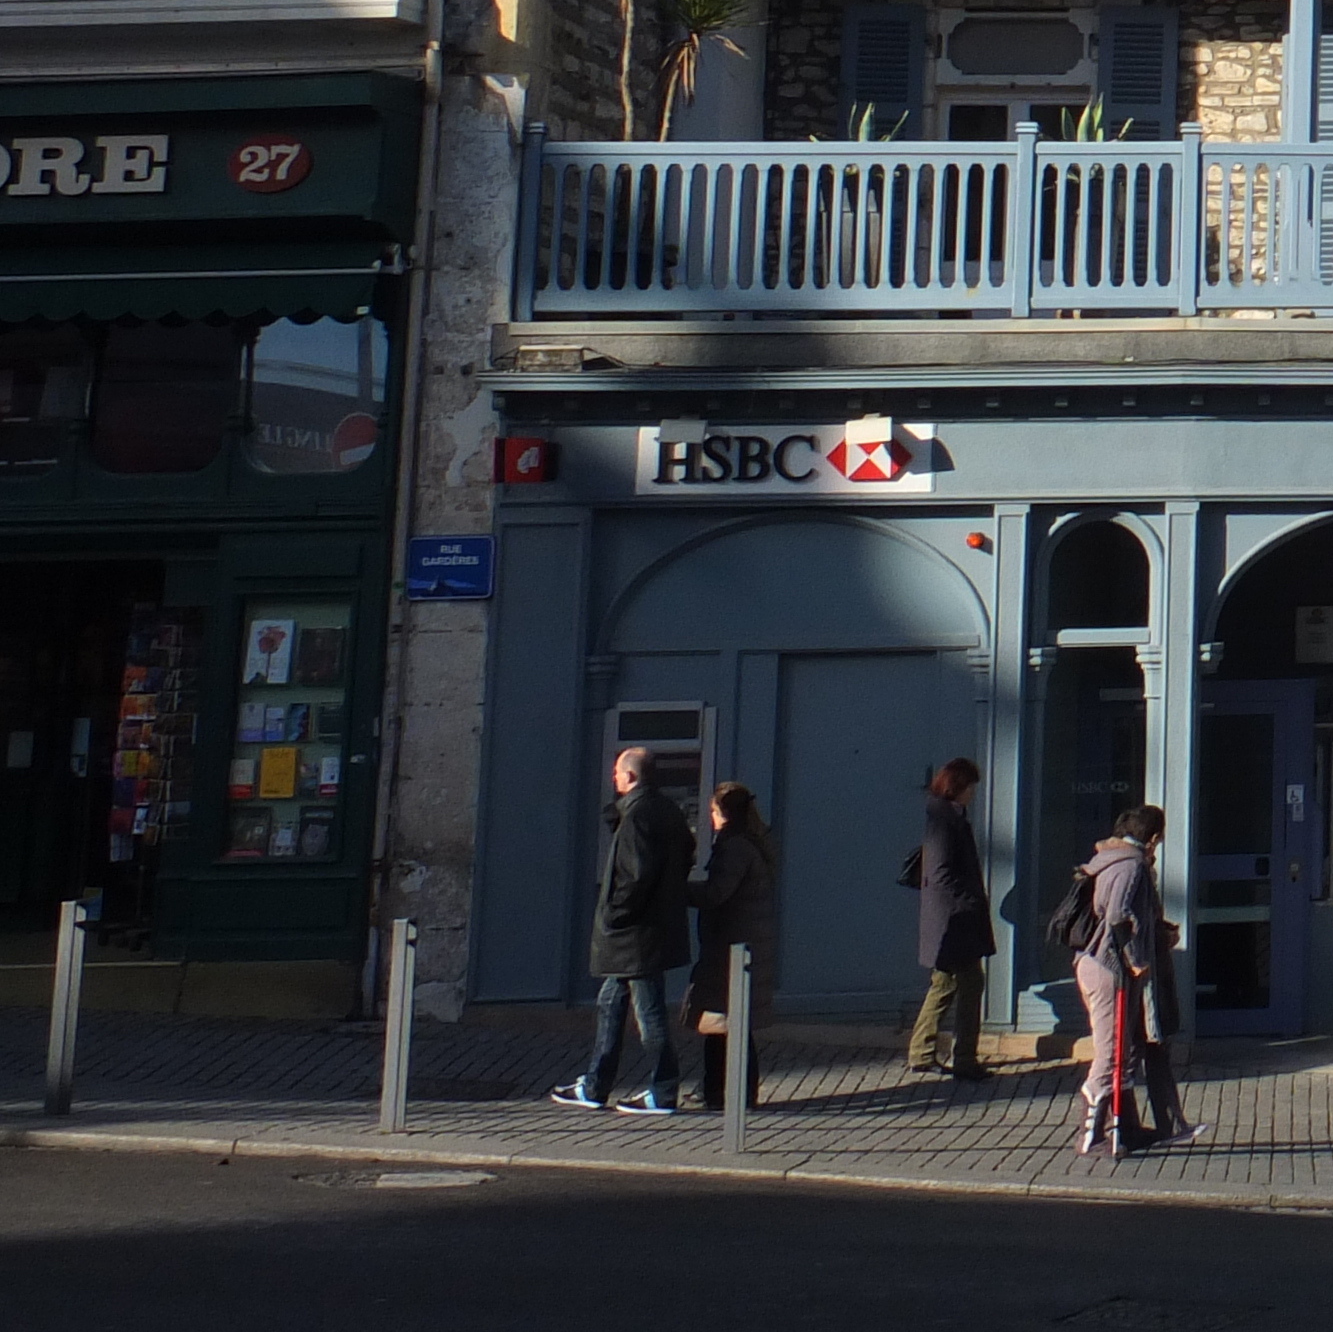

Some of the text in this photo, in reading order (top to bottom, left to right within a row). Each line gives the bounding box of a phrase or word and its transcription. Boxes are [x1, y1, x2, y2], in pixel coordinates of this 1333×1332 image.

[240, 144, 300, 182] 27
[653, 434, 821, 484] HSBC
[441, 544, 462, 554] RUE
